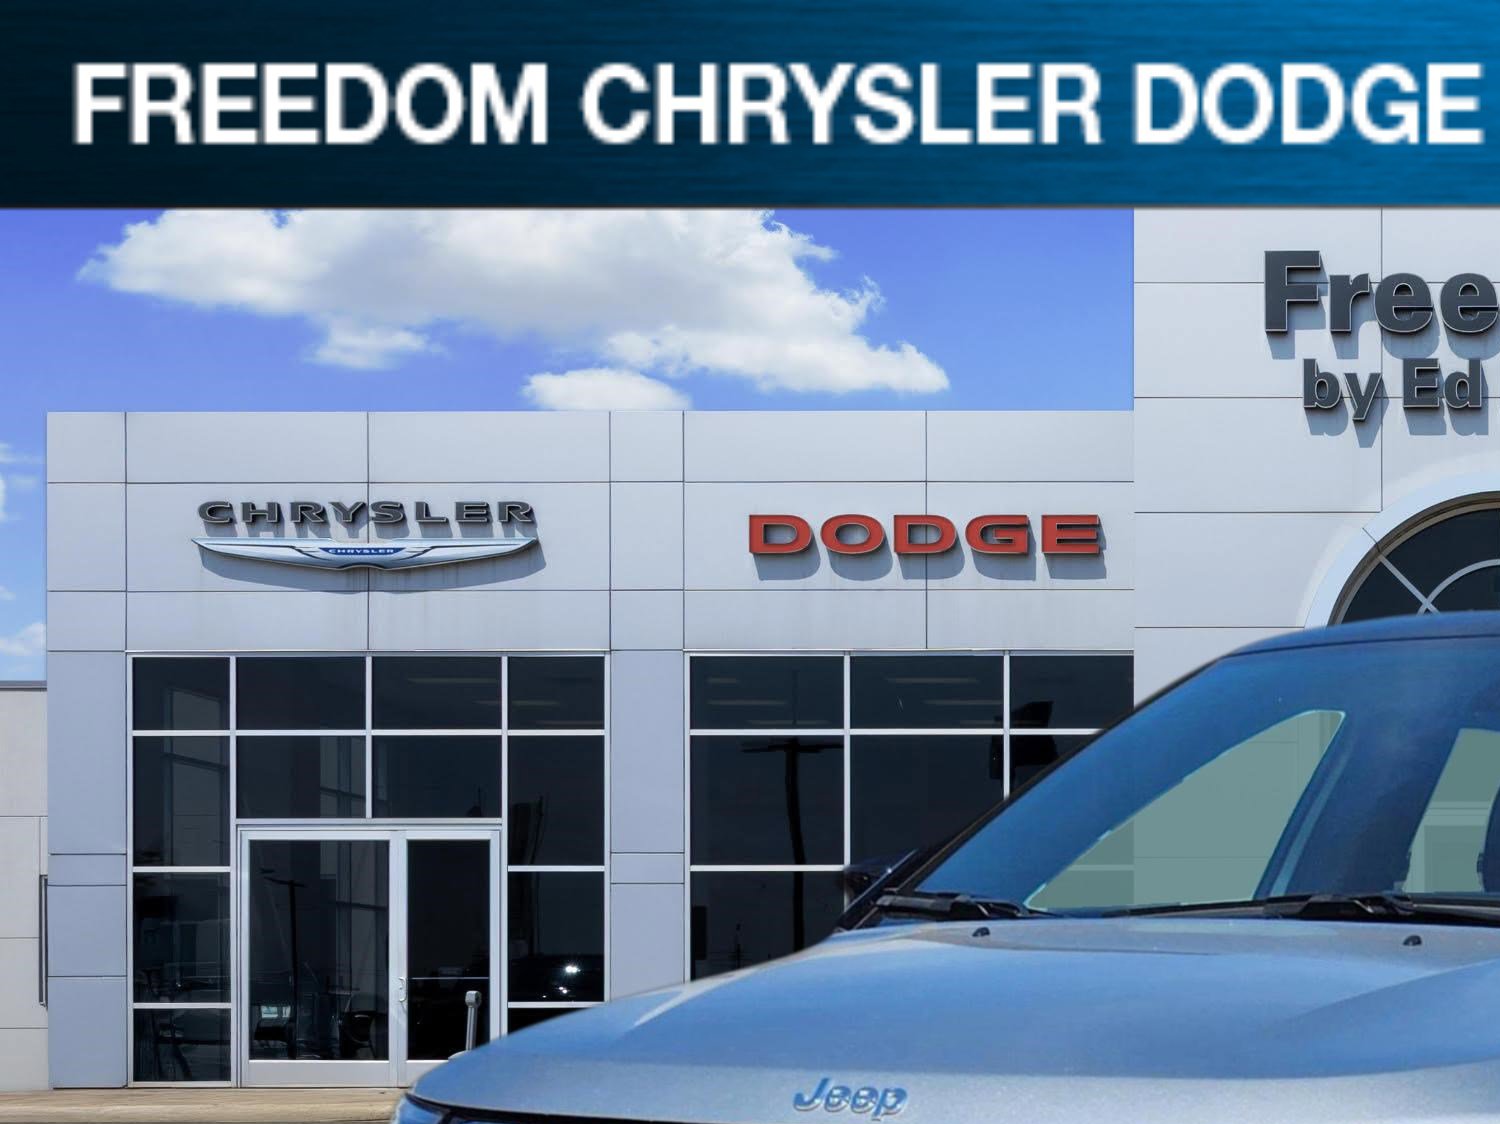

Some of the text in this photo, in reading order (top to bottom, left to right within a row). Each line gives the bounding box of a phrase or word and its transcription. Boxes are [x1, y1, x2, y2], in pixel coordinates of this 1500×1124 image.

[1303, 358, 1381, 421] by
[1402, 358, 1482, 409] Ed
[197, 500, 534, 525] CHRYSLER
[748, 514, 1102, 555] DODGE
[793, 1077, 908, 1122] Jeep
